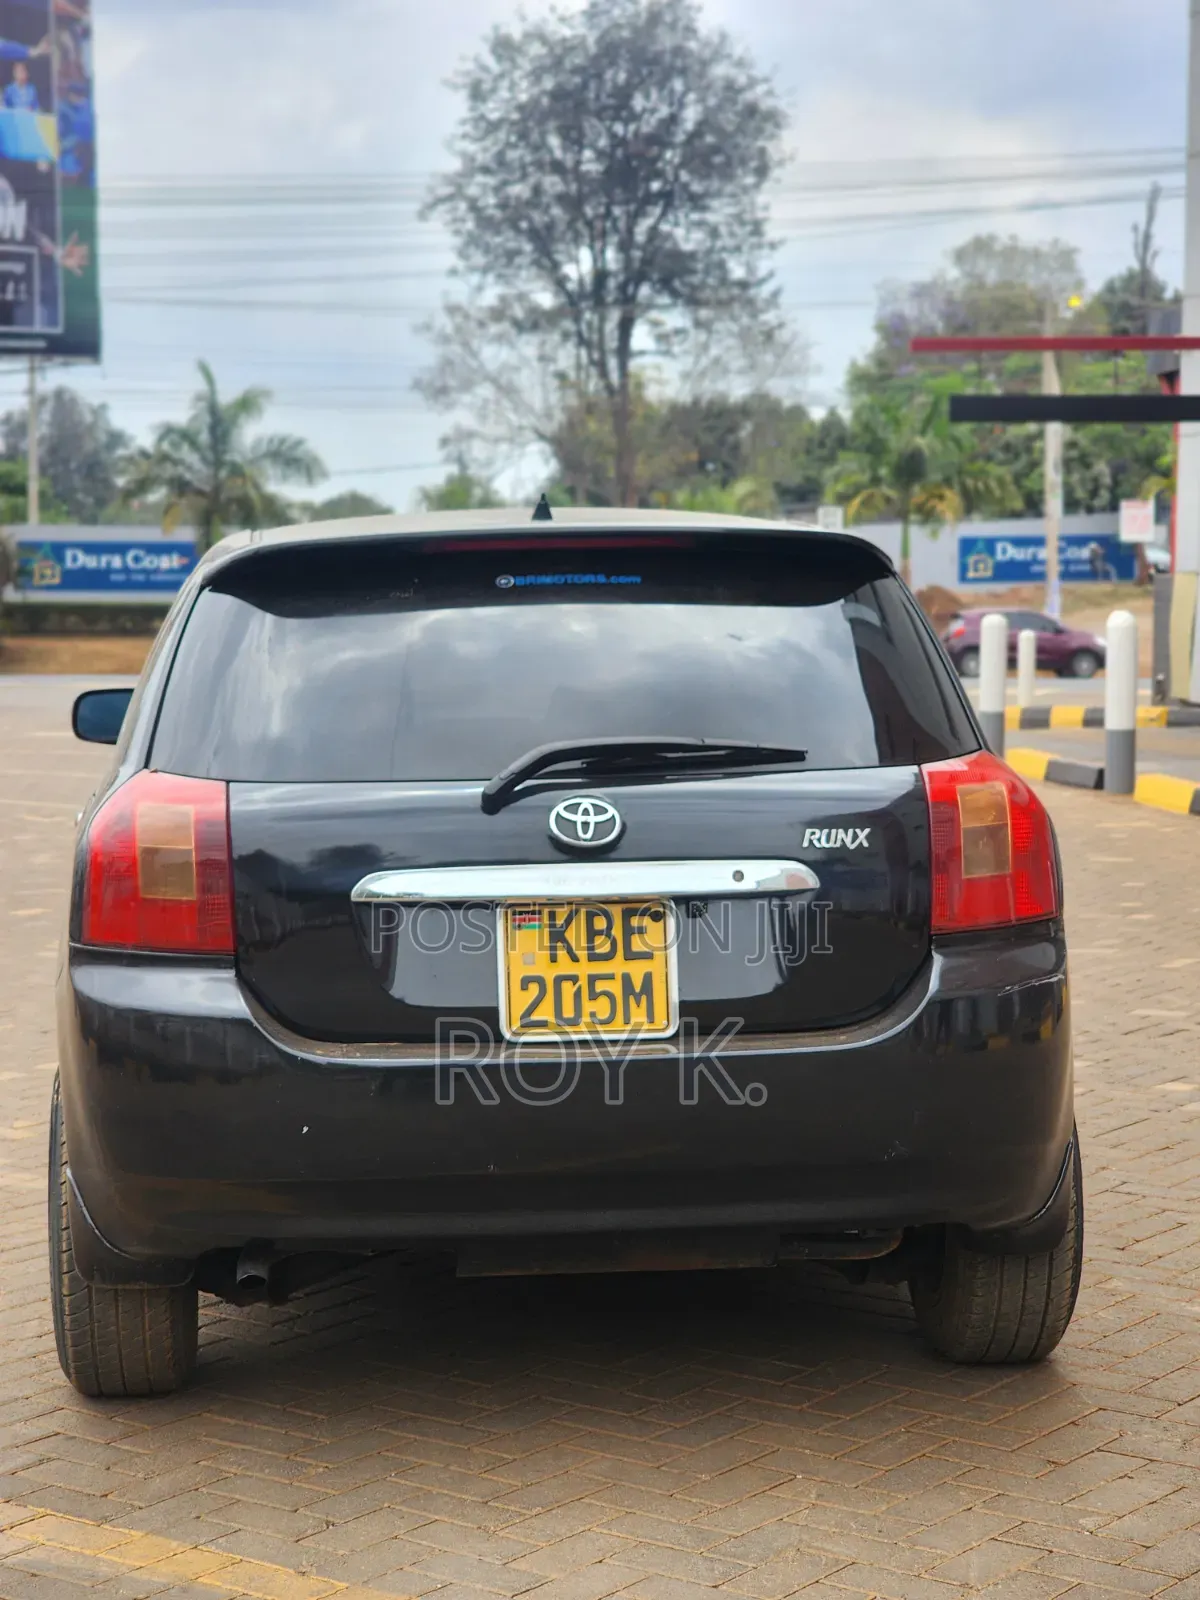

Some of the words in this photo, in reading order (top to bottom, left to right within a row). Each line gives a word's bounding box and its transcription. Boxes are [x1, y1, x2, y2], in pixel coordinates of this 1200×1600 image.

[802, 827, 871, 850] RUNX
[547, 907, 655, 963] KBE
[519, 971, 655, 1028] 205M
